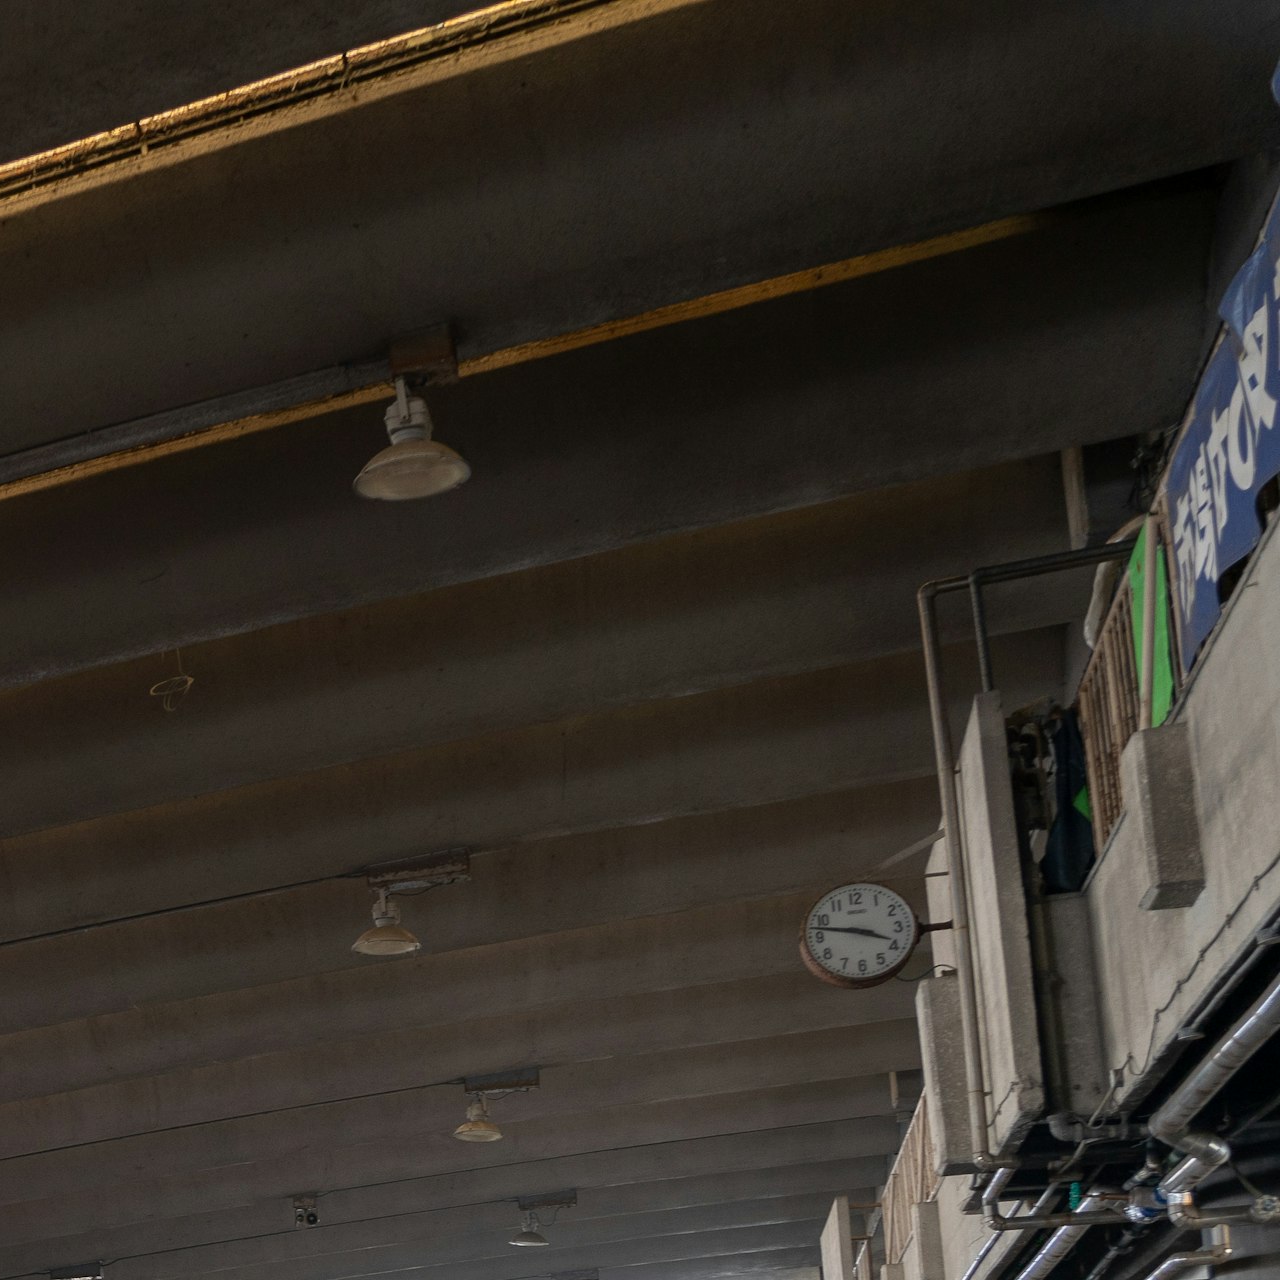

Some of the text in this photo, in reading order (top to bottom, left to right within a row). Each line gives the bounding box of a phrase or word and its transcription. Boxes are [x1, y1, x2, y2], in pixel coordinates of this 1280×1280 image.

[848, 892, 862, 905] 12
[873, 894, 879, 906] 1
[831, 900, 842, 912] 11
[887, 904, 897, 917] 2
[817, 914, 829, 926] 10
[894, 921, 903, 933] 3
[815, 931, 824, 943] 9
[888, 939, 899, 951] 4
[823, 948, 833, 959] 8
[876, 952, 885, 965] 5
[840, 957, 849, 970] 7
[858, 959, 867, 972] 6
